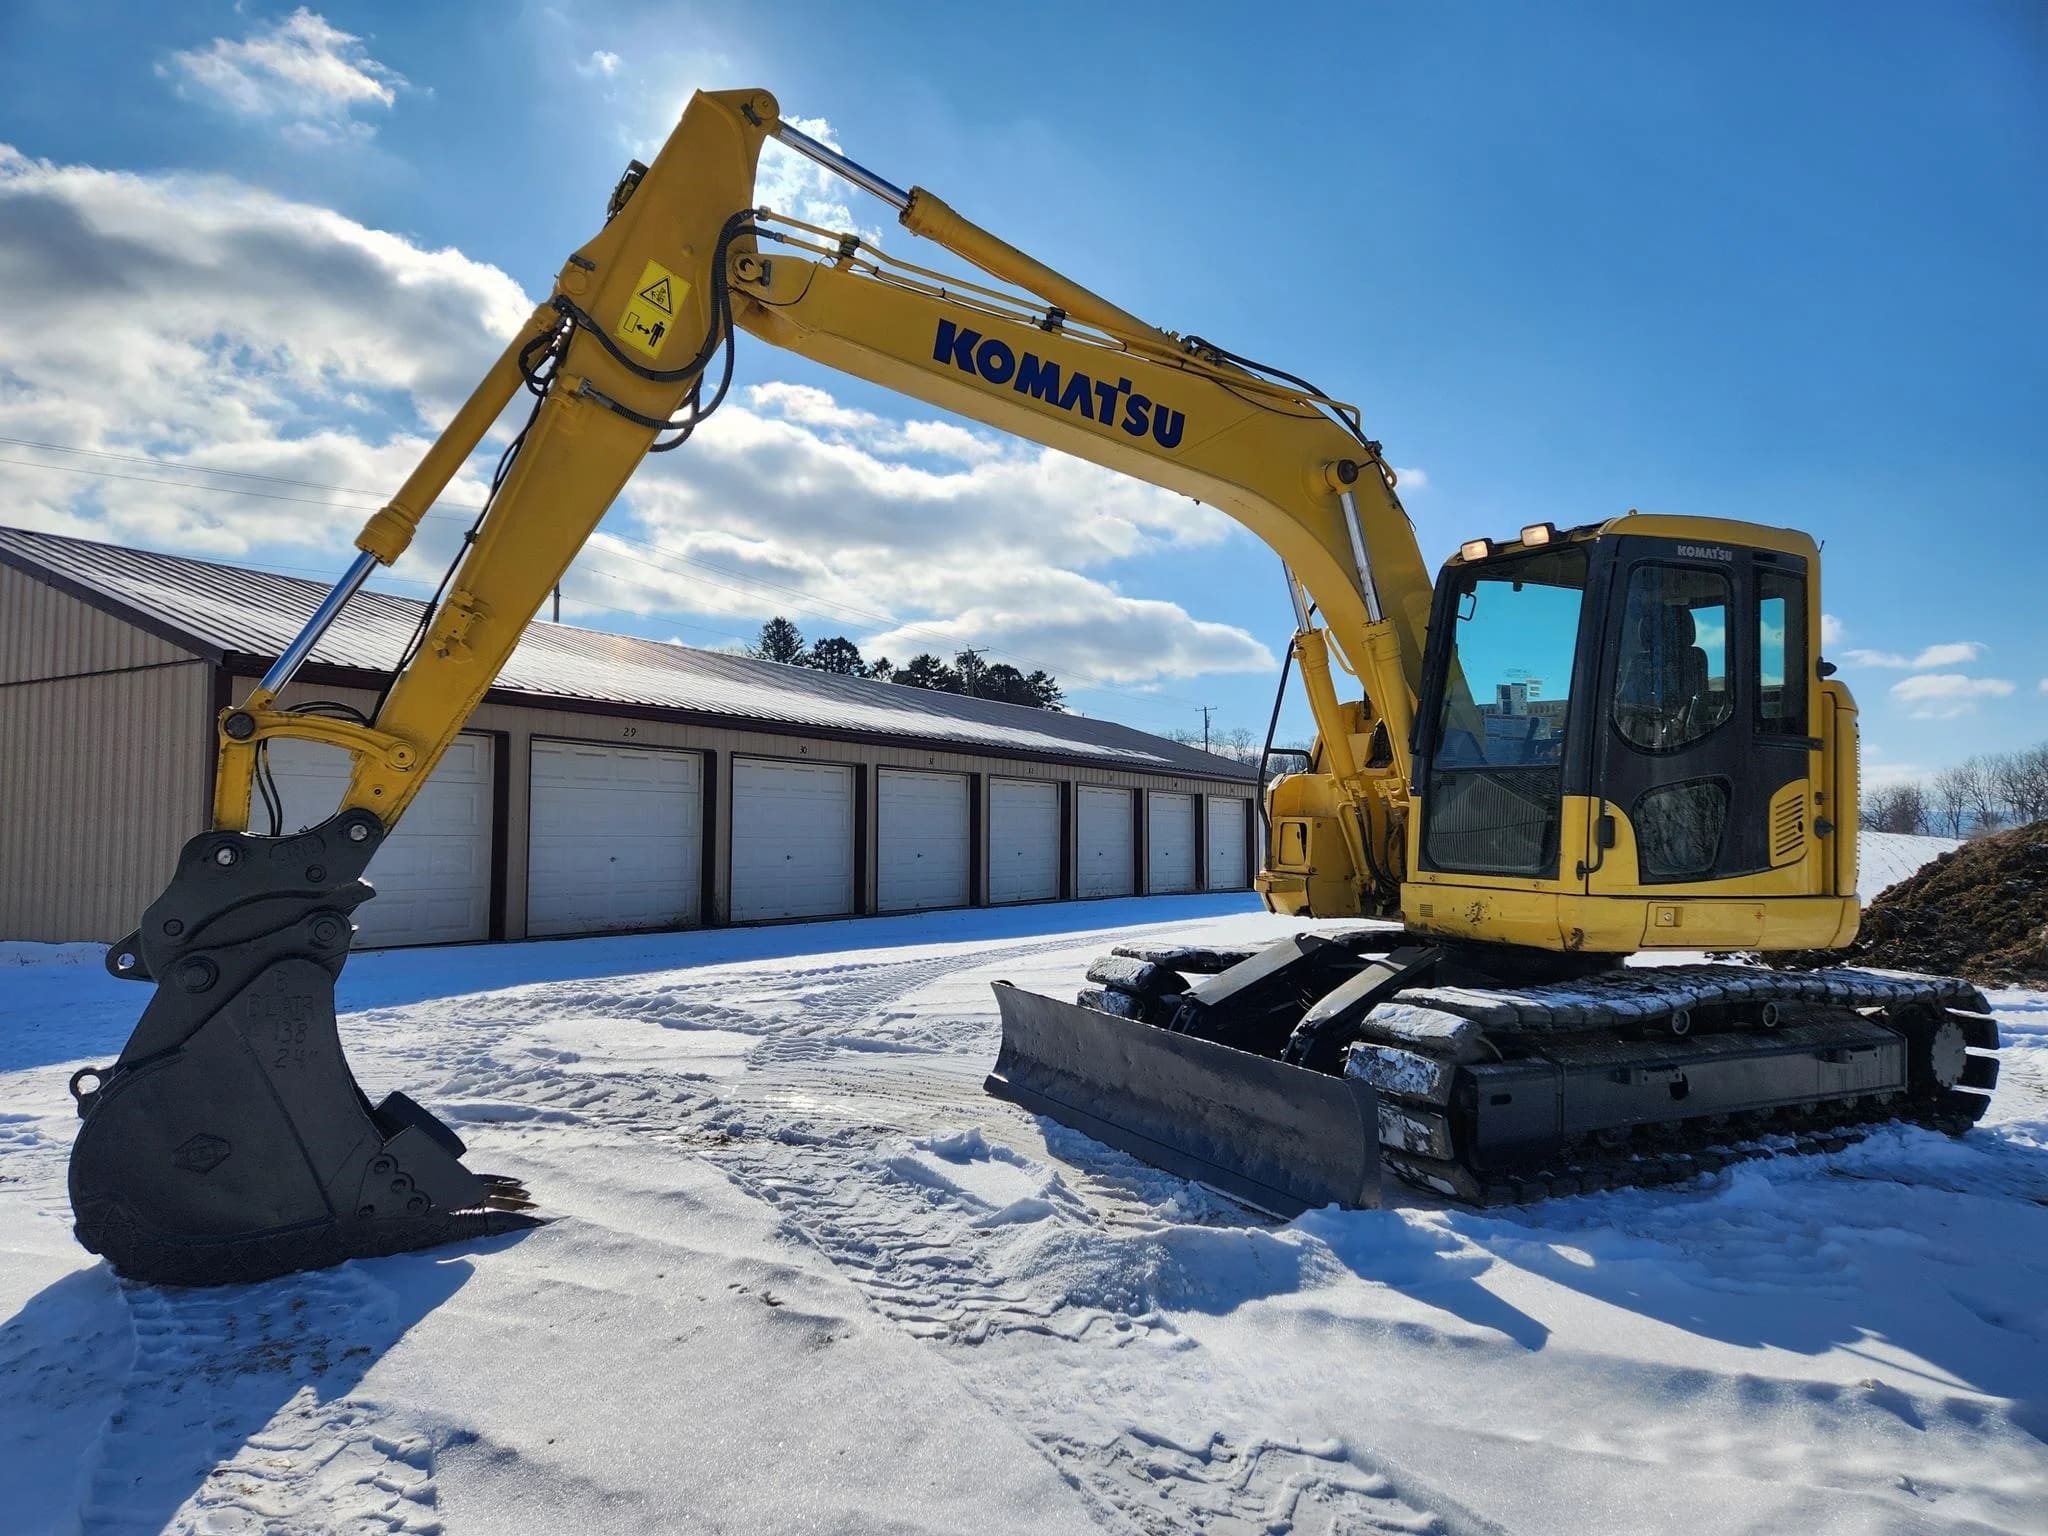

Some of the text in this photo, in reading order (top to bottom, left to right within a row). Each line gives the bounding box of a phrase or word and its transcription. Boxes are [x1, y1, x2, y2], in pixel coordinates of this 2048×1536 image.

[933, 318, 1185, 448] KOMATSU
[1677, 545, 1733, 561] KOMATSU
[623, 727, 637, 738] 29
